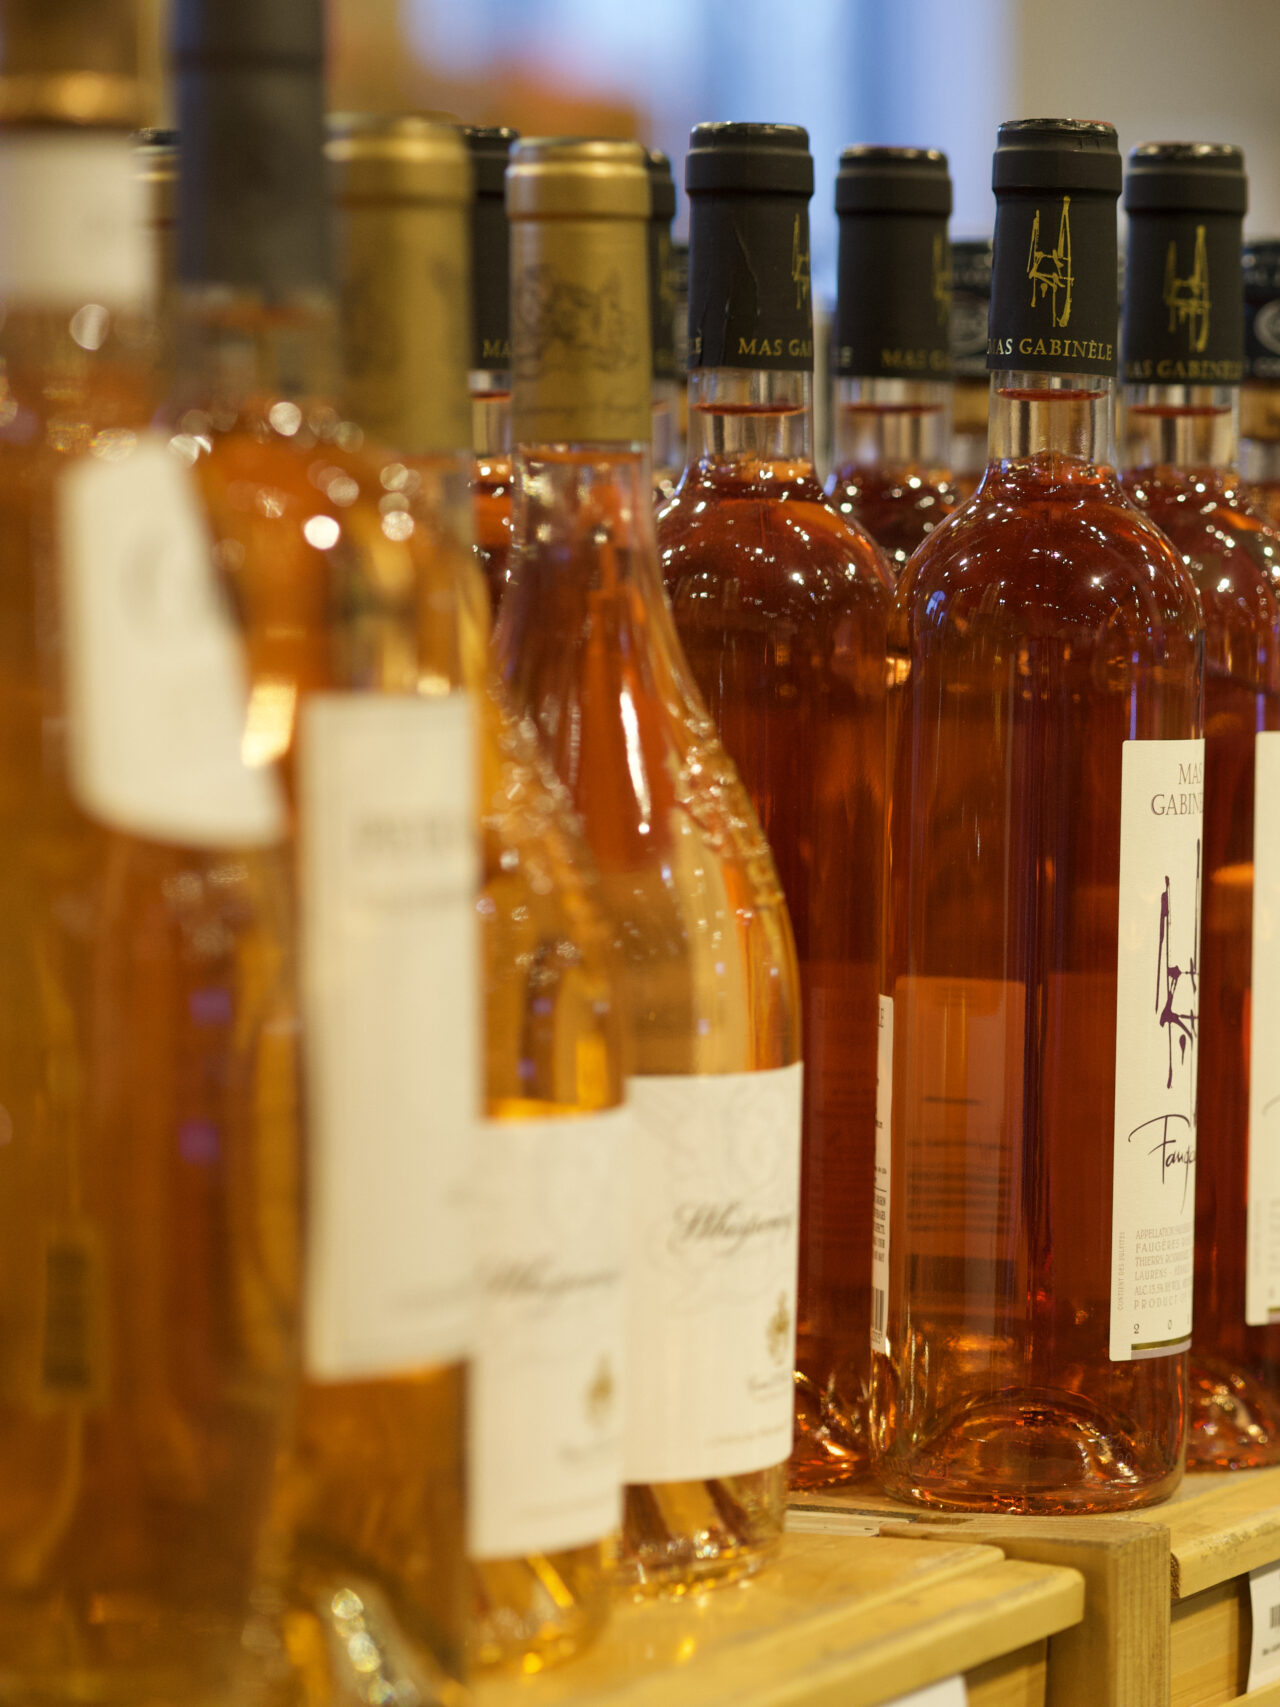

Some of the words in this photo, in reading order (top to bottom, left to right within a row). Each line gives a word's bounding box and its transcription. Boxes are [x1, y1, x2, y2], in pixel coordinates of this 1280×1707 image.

[738, 337, 782, 356] MAS
[987, 338, 1013, 355] MAS
[1019, 338, 1113, 362] GABINÈLE
